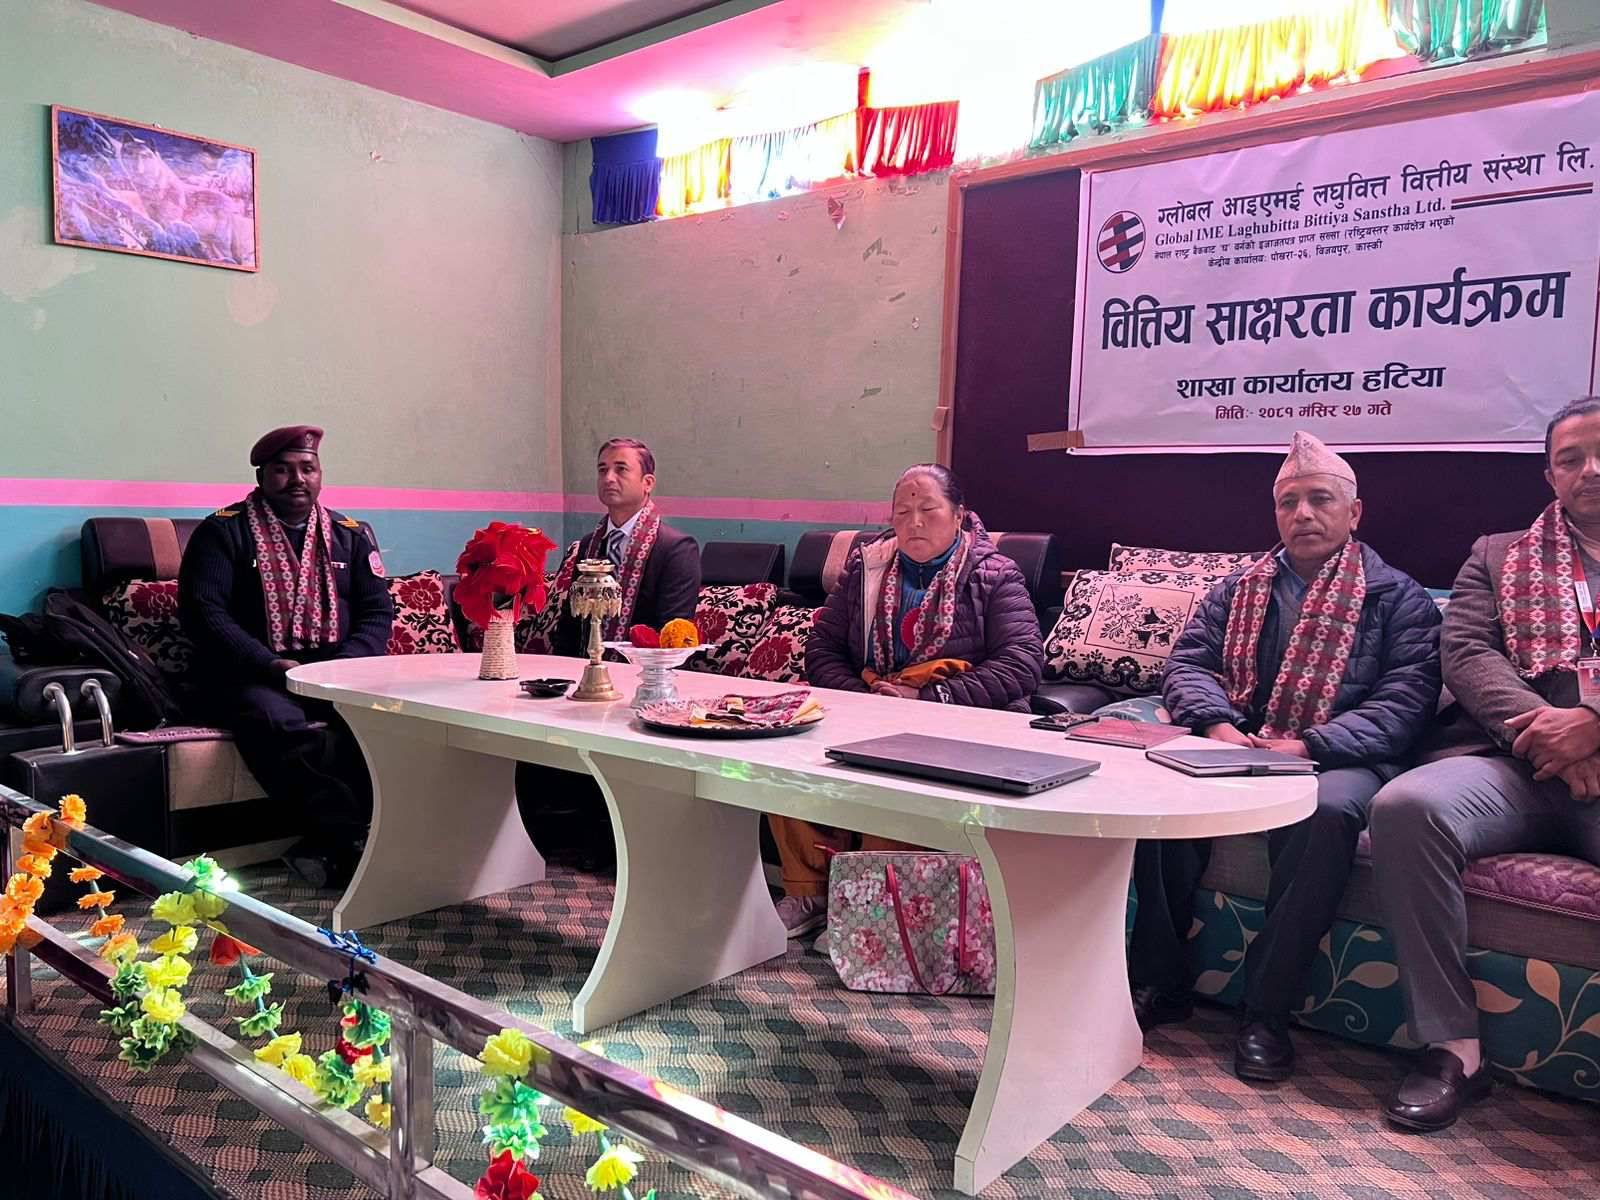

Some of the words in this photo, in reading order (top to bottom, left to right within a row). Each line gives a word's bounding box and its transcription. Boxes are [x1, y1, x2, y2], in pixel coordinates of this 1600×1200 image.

[1158, 201, 1213, 226] ग्लोबल
[1222, 182, 1304, 217] आइएमई
[1313, 172, 1391, 209] लघुवित्त
[1401, 160, 1472, 193] वित्तीय
[1483, 154, 1546, 183] संस्था
[1556, 141, 1594, 172] लि.
[1155, 230, 1193, 246] Global
[1197, 225, 1224, 241] IME
[1228, 218, 1299, 238] Laghubitta
[1304, 211, 1348, 228] Bittiya
[1353, 202, 1410, 222] Sanstha
[1415, 198, 1446, 214] Ltd.
[1102, 294, 1195, 350] वित्तिय
[1206, 291, 1356, 345] साक्षरता
[1368, 267, 1571, 330] कार्यक्रम
[1176, 377, 1236, 399] शाखा
[1243, 369, 1354, 394] कार्यालय
[1362, 362, 1446, 393] हटिया
[1258, 406, 1293, 418] २०८१
[1298, 402, 1338, 417] मंसिर
[1343, 405, 1361, 417] २७
[1368, 400, 1392, 416] गते
